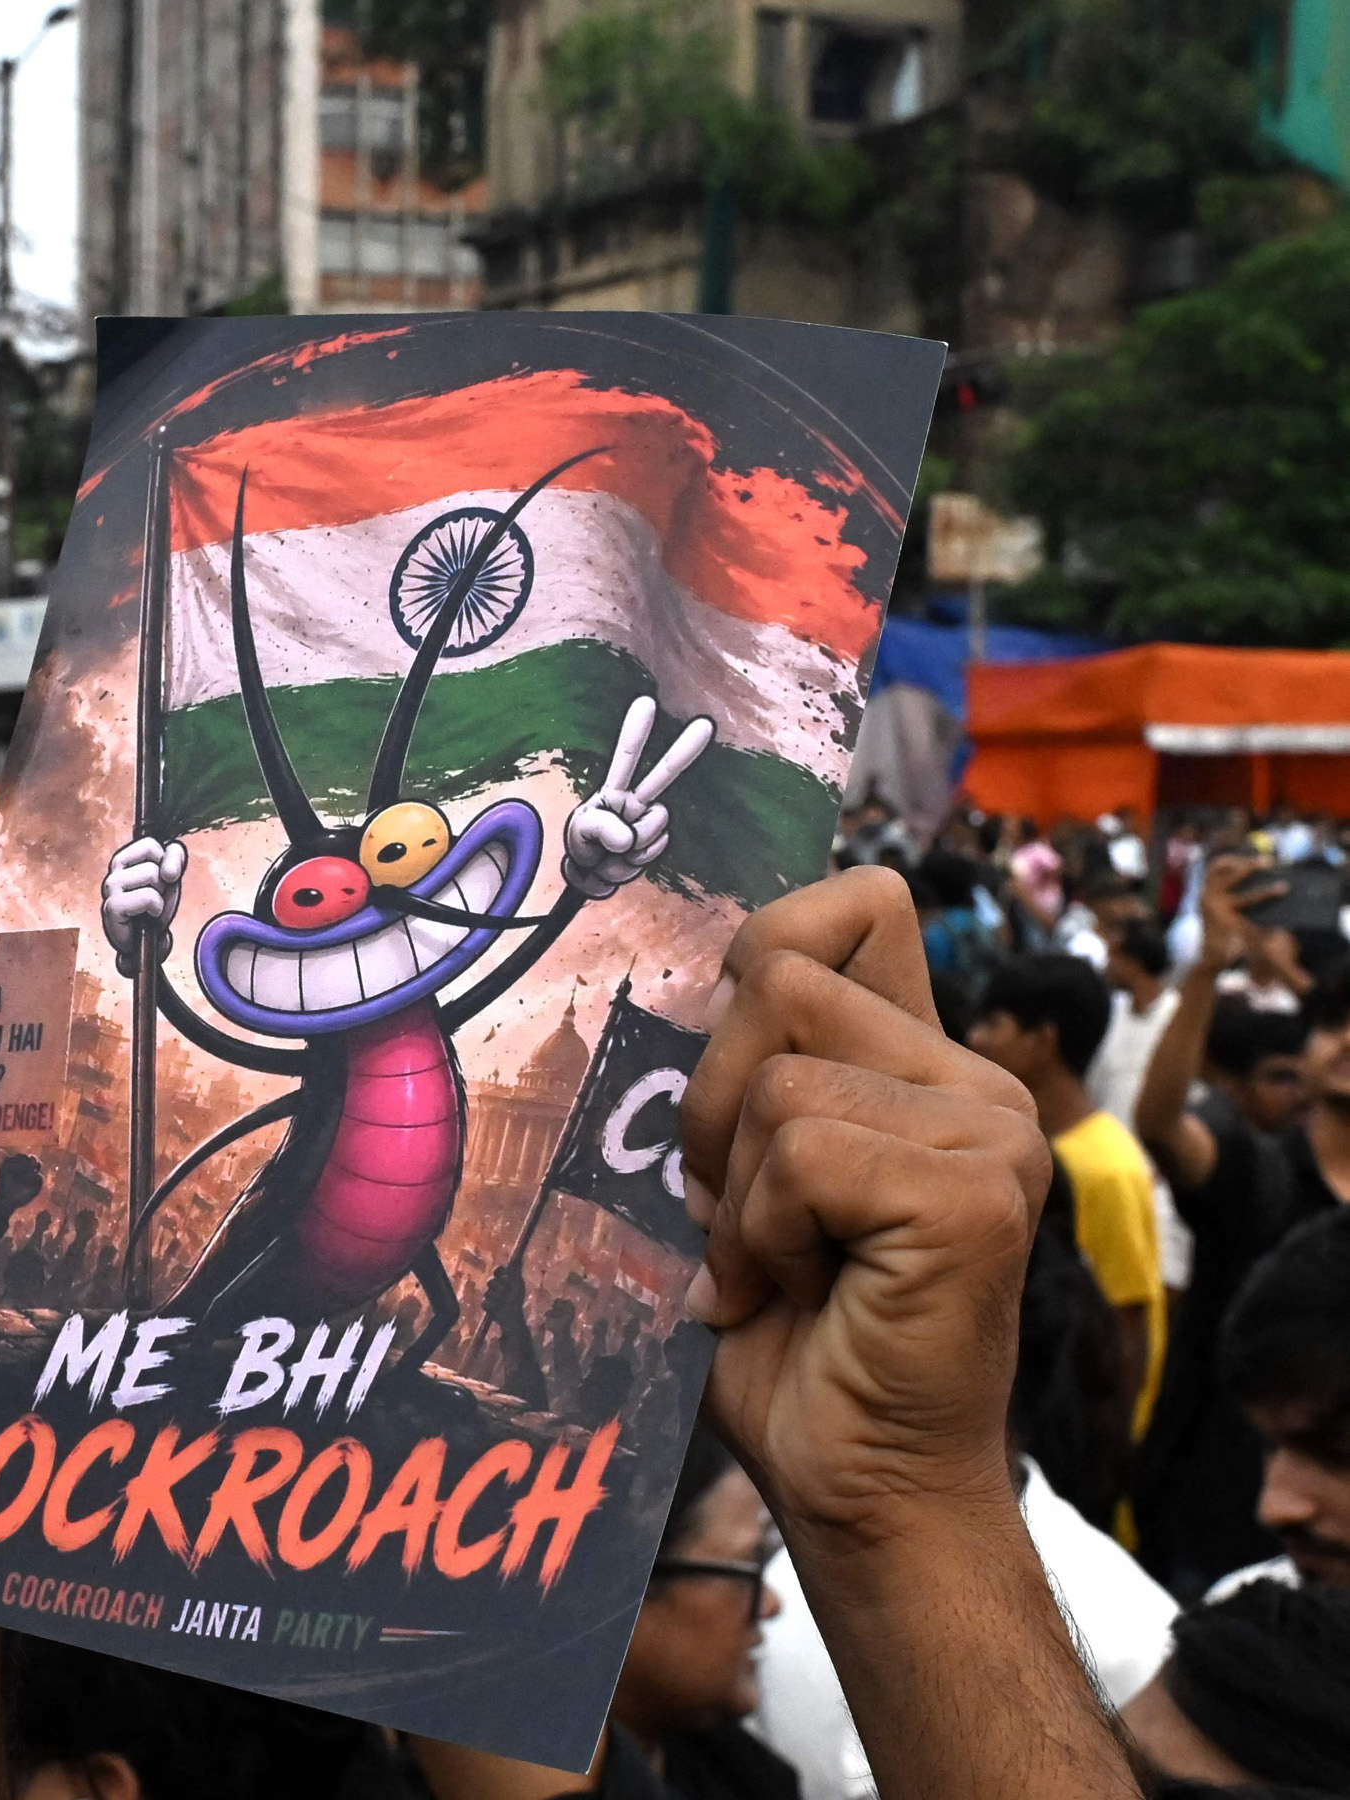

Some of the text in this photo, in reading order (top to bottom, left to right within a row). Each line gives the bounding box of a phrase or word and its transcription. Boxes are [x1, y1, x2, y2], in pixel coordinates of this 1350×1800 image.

[8, 1022, 43, 1052] HAI
[602, 1067, 688, 1198] C
[32, 1309, 397, 1421] ME BHI
[2, 1571, 374, 1652] COCKROACH JANTA PARTY
